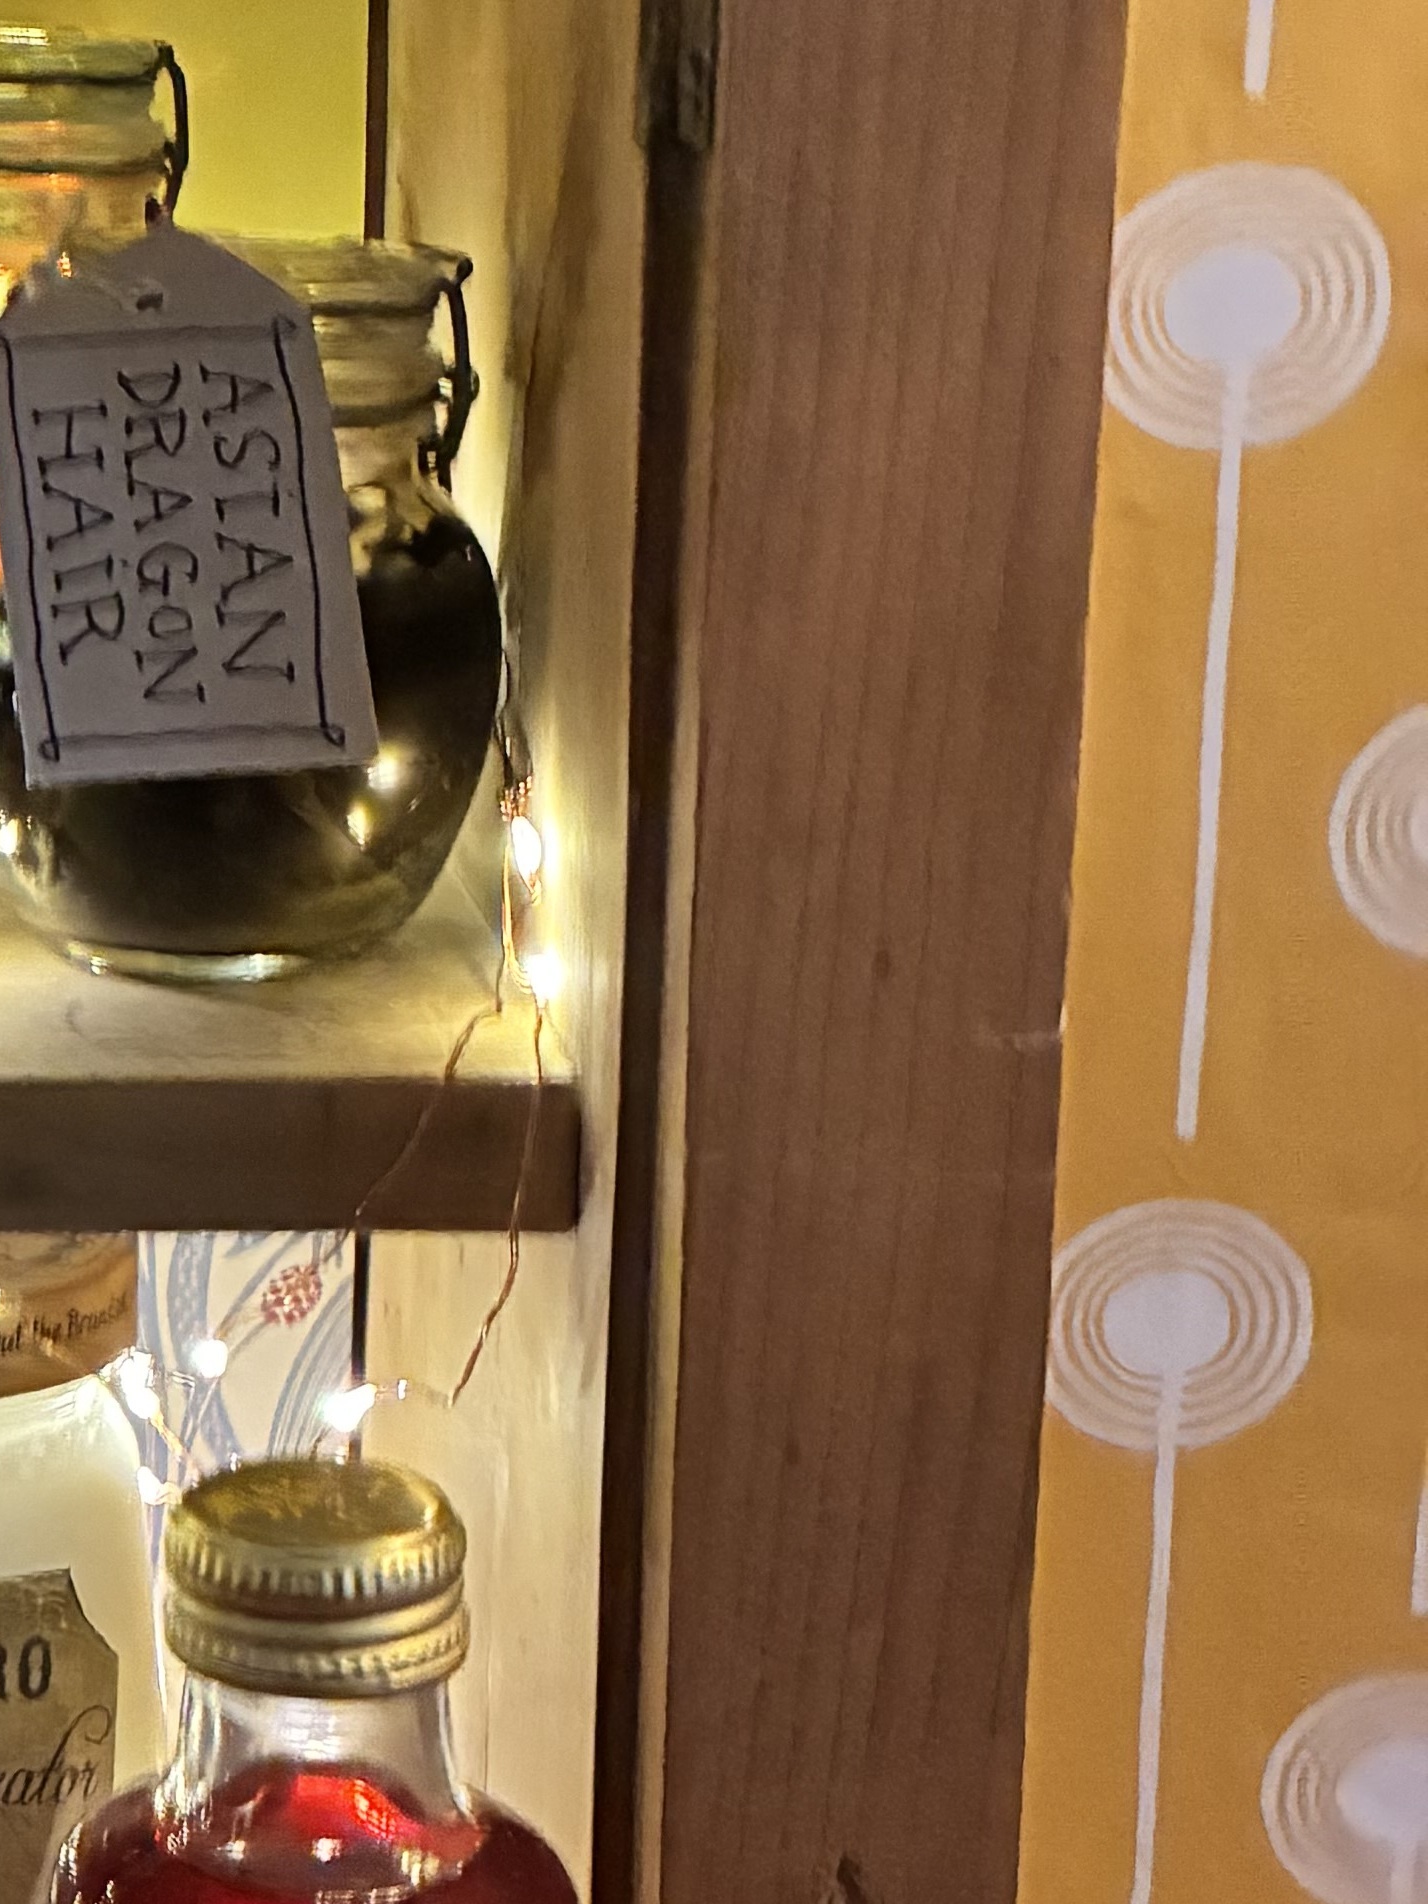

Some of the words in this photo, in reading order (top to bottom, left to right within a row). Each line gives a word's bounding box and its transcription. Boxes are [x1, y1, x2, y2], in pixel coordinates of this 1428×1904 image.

[33, 401, 125, 666] HAIR
[118, 362, 205, 704] DRAGON
[200, 363, 295, 685] ASIAN
